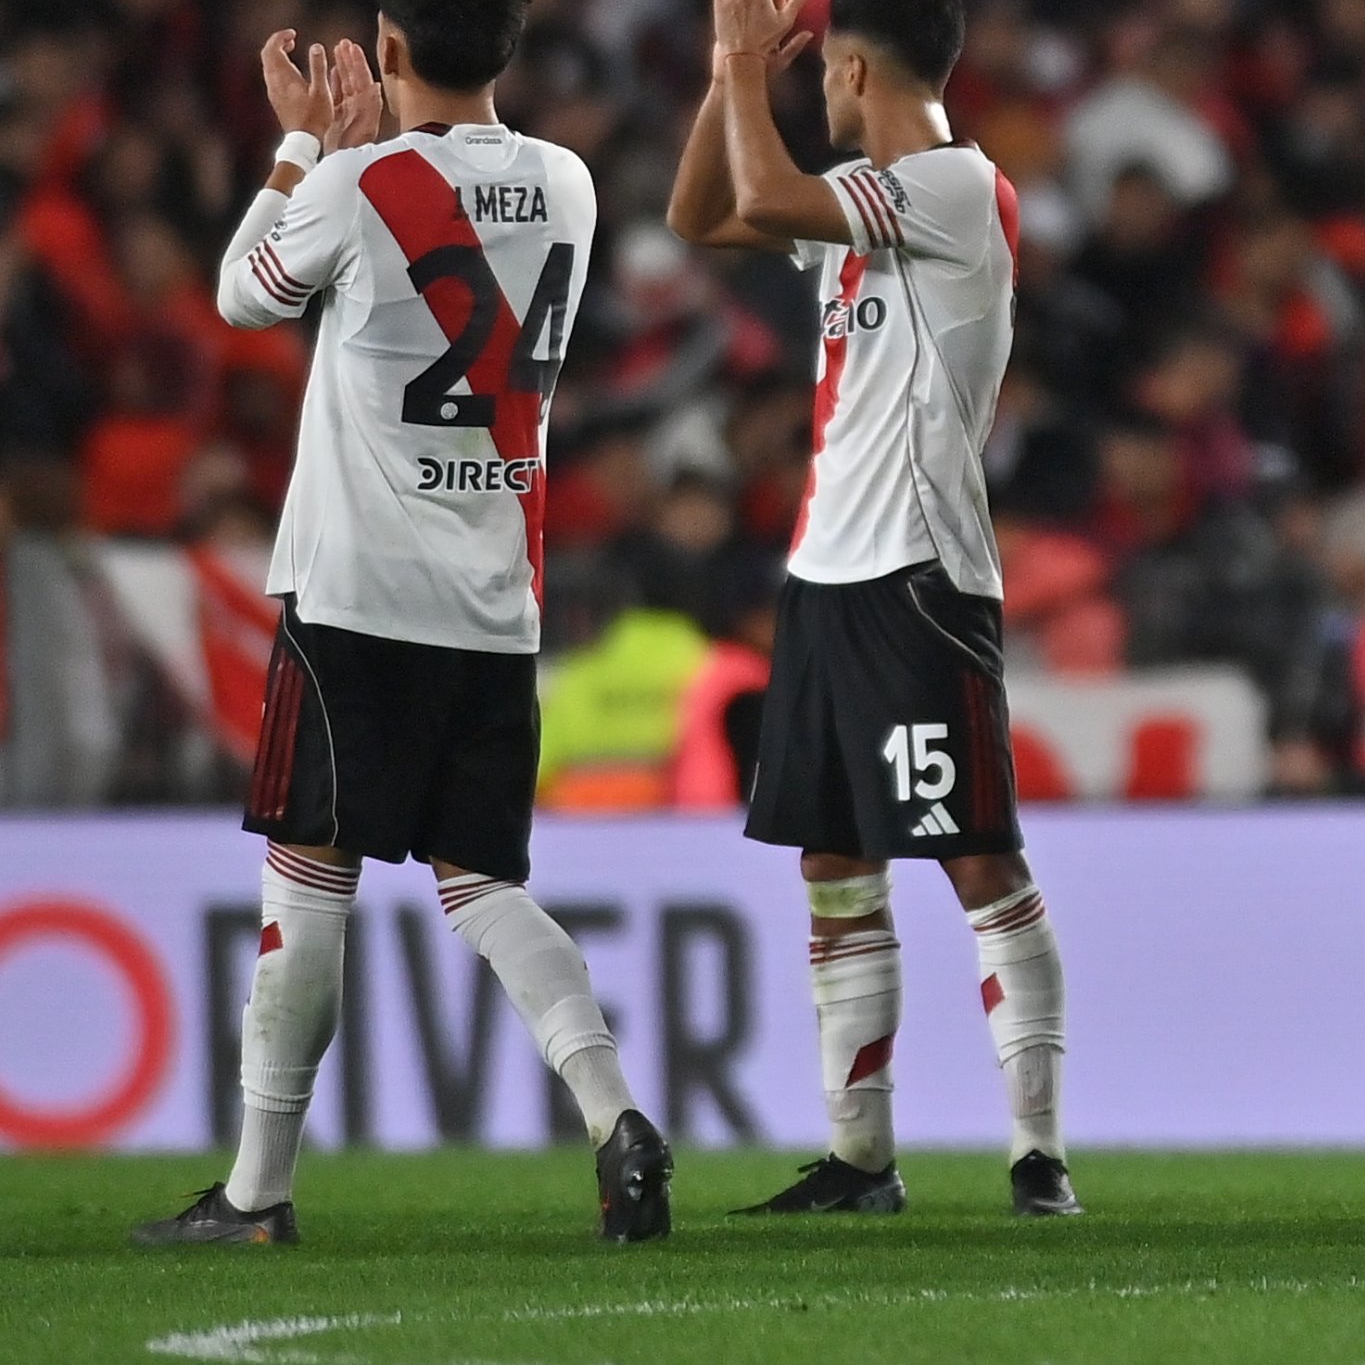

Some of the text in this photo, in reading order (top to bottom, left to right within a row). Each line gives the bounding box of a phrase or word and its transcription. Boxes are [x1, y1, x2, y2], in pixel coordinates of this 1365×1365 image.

[475, 186, 548, 223] MEZA
[401, 242, 575, 428] 24
[416, 457, 538, 493] DIRECT
[883, 723, 956, 801] 15
